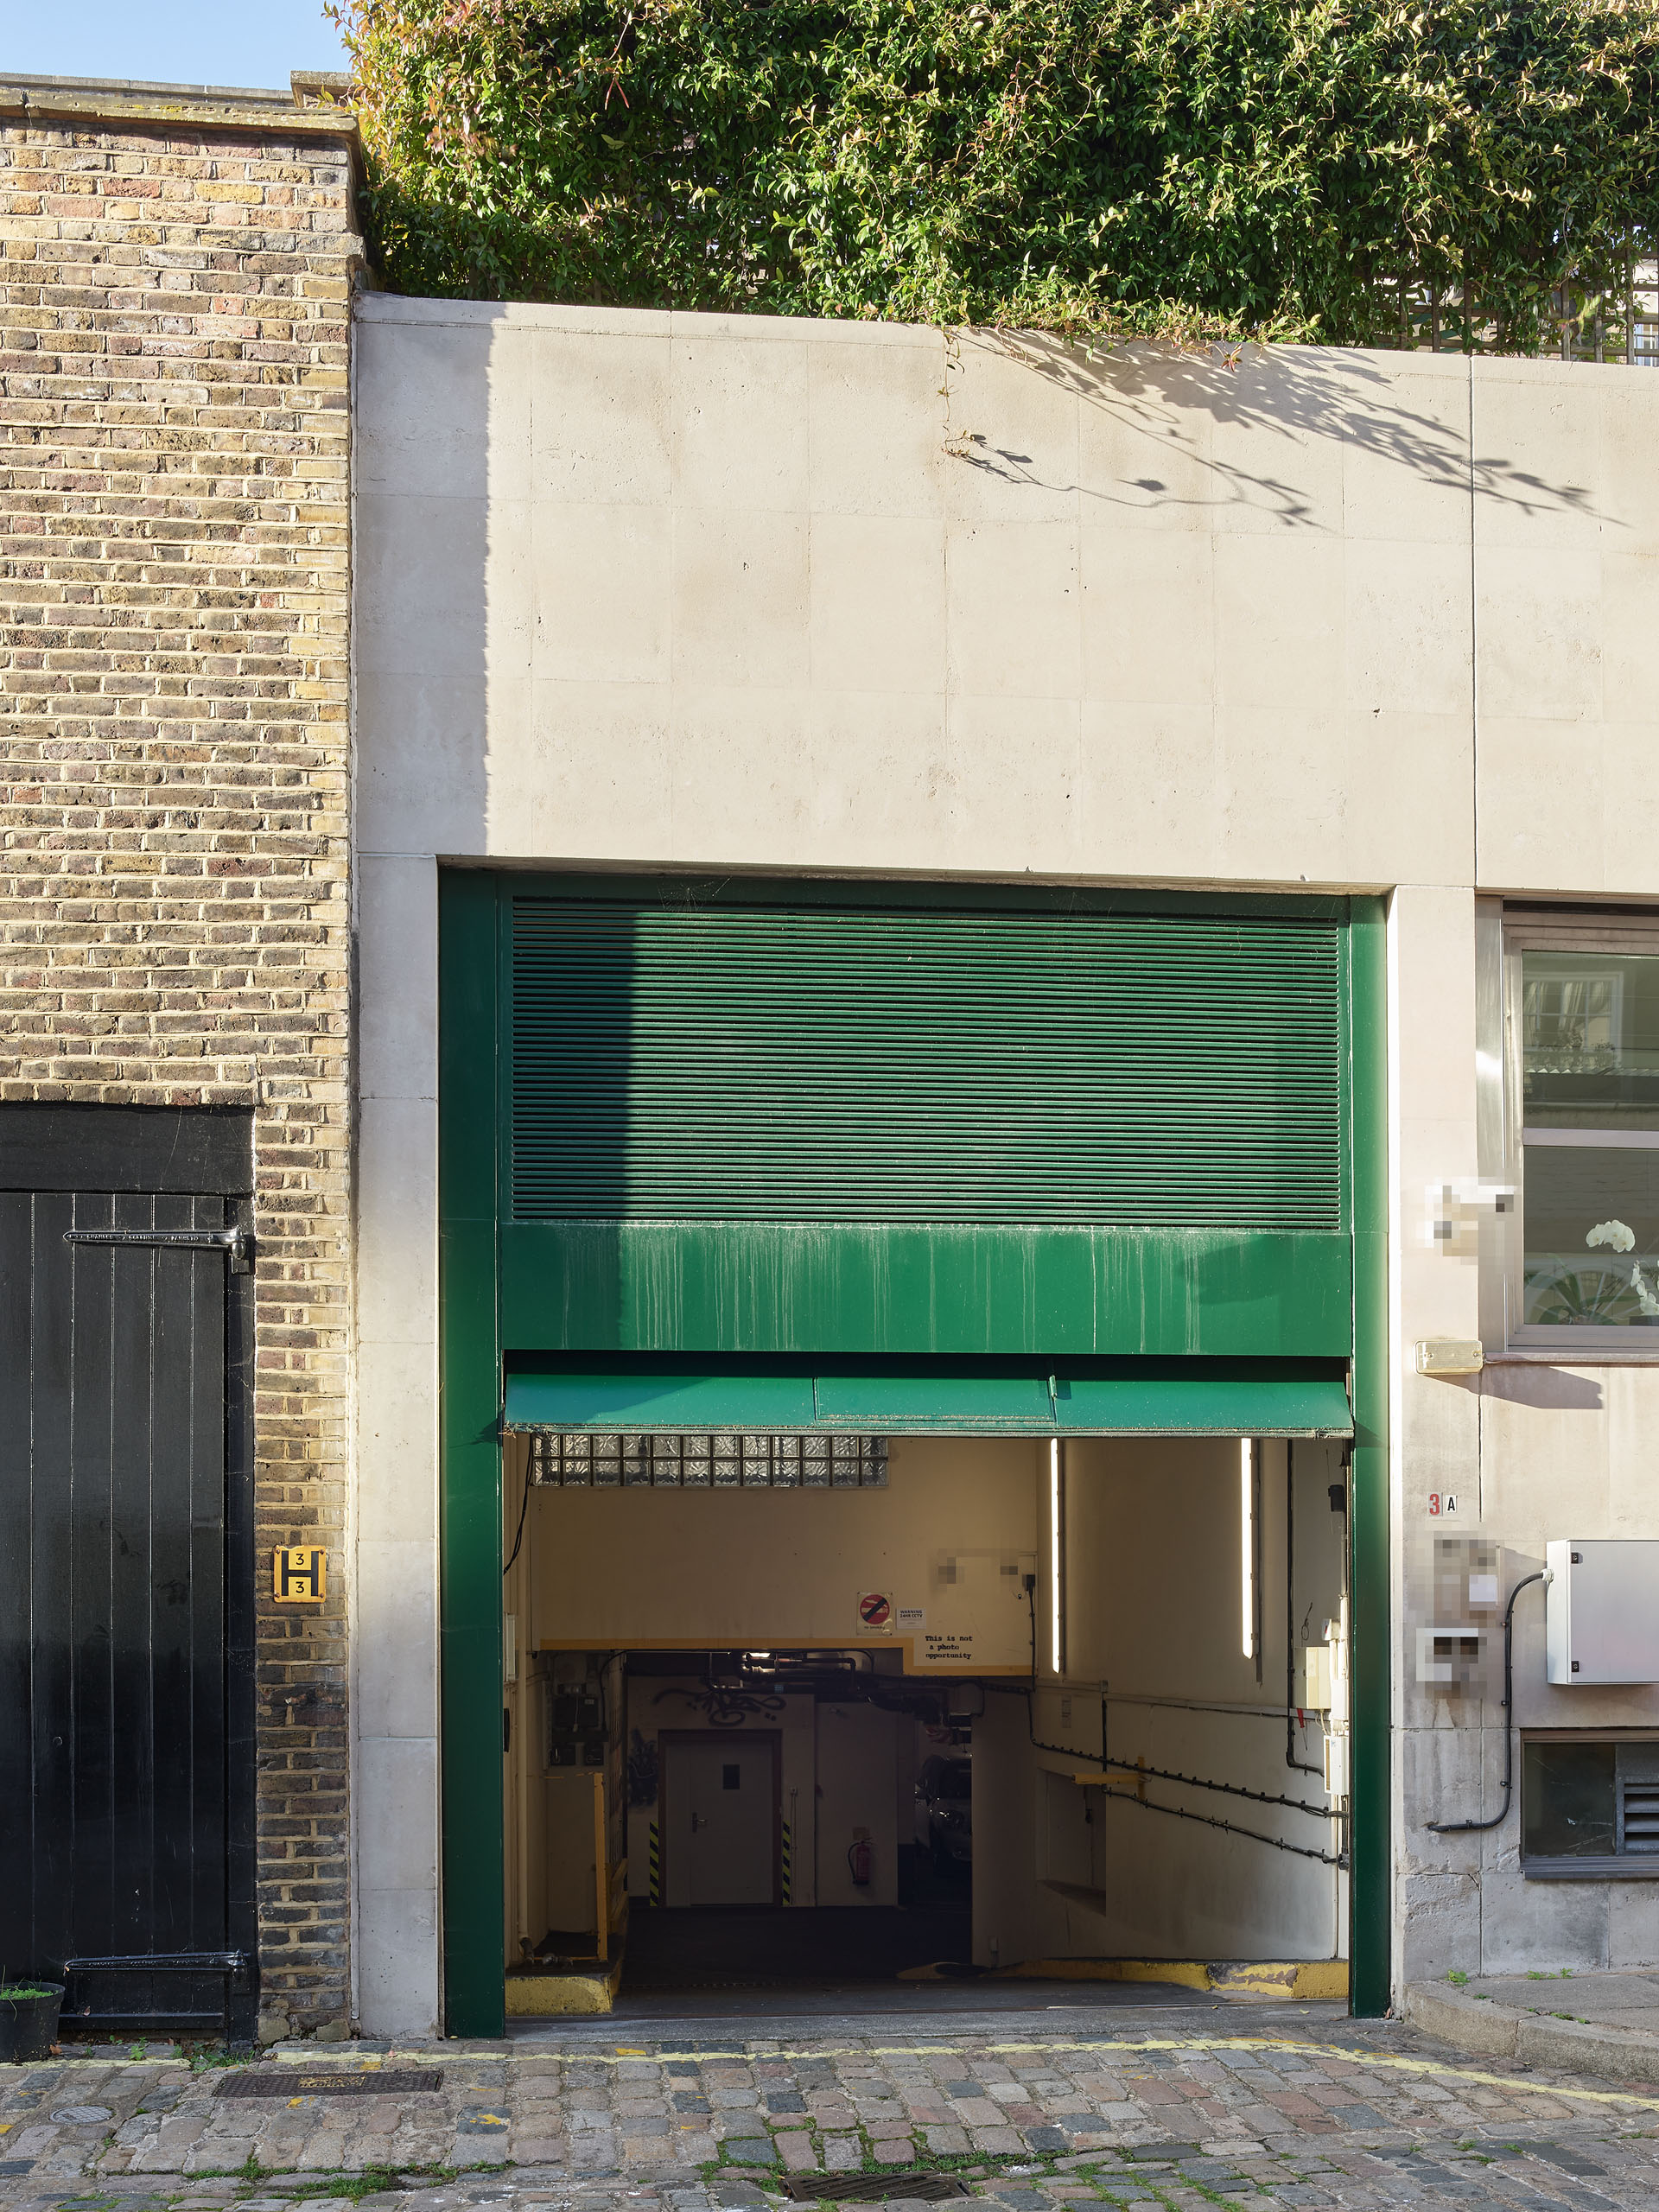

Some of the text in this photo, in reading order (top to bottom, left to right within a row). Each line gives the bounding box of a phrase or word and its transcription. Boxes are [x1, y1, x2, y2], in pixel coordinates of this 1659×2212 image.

[296, 1553, 305, 1566] 3
[282, 1550, 319, 1596] H
[296, 1581, 305, 1593] 3
